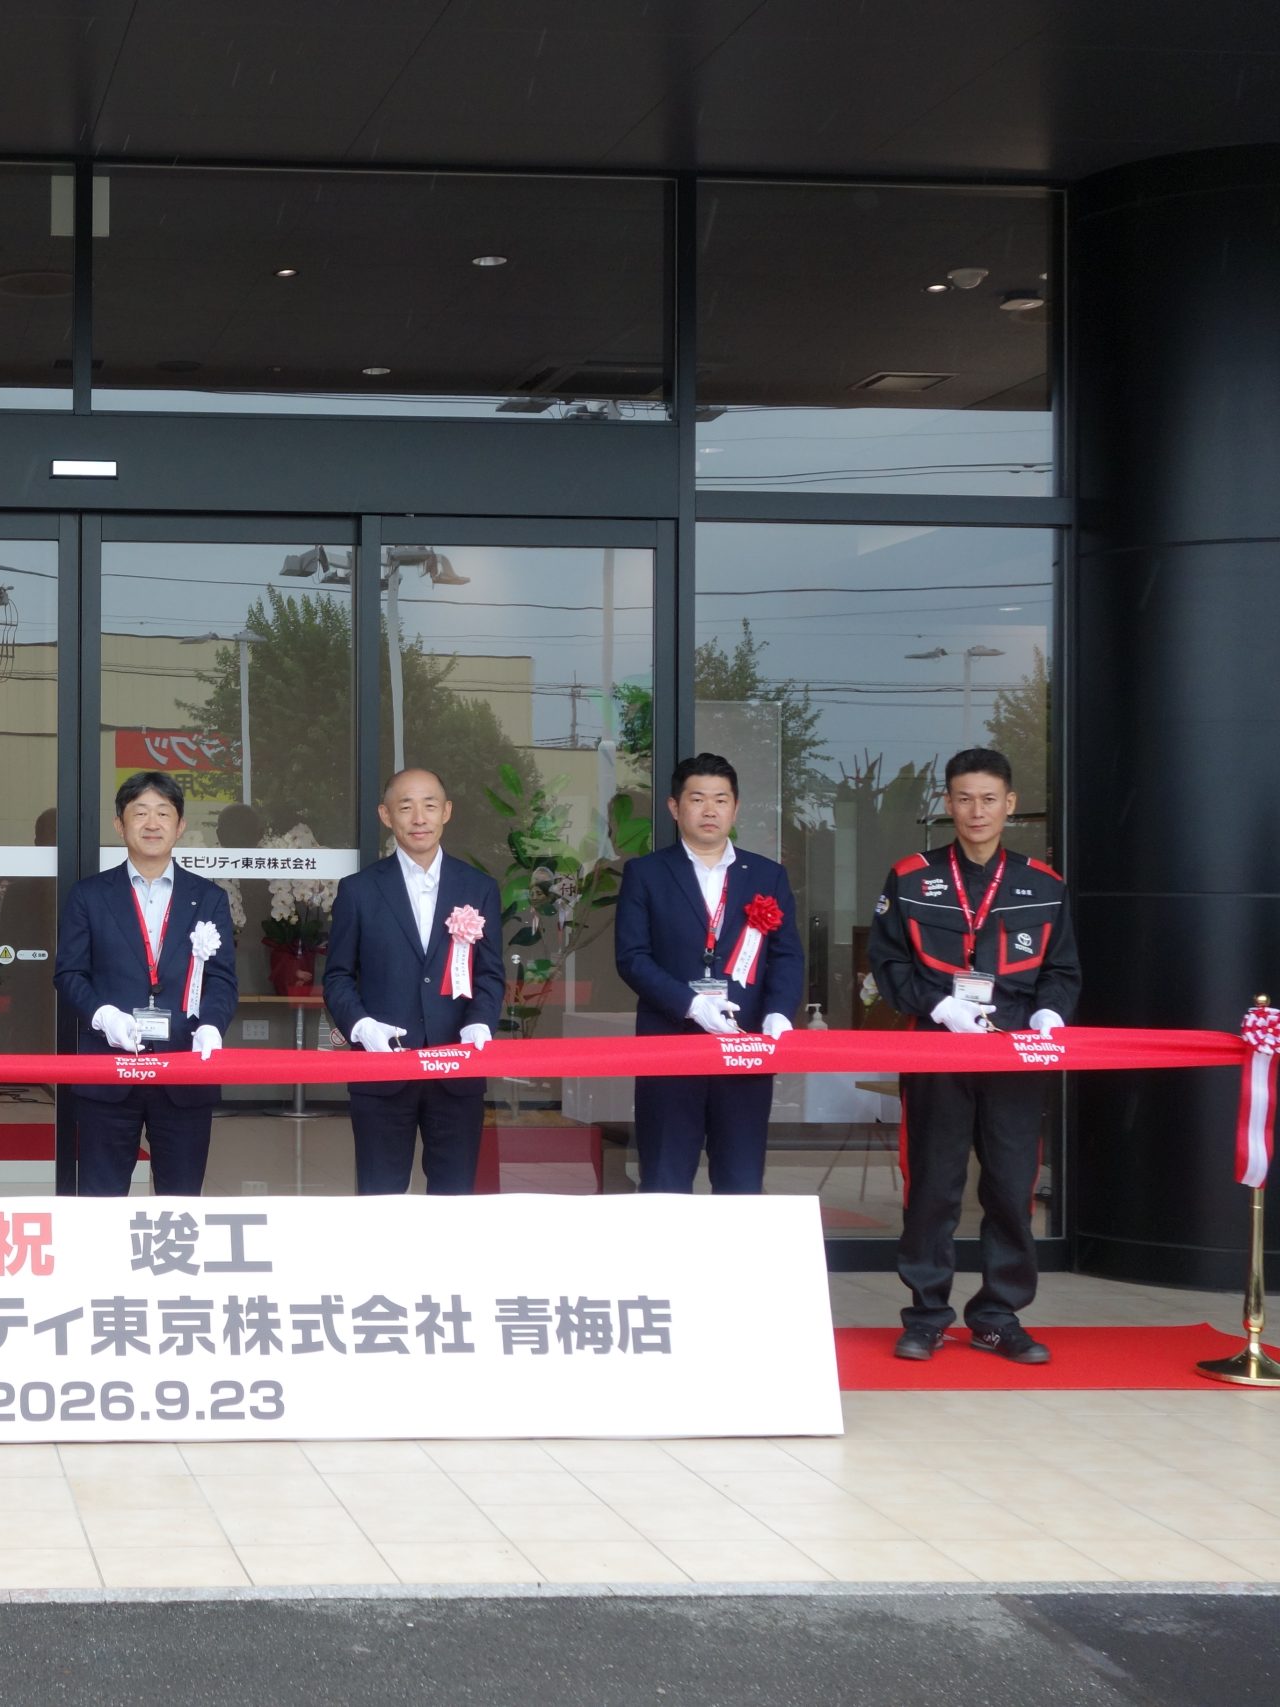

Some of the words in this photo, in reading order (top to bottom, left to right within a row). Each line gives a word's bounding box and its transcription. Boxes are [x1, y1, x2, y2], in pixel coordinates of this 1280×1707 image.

[181, 856, 317, 870] モビリティ東京株式会社
[721, 1043, 776, 1055] Mobility
[1013, 1042, 1066, 1053] Mobility
[723, 1056, 763, 1068] Tokyo
[1019, 1052, 1059, 1065] Tokyo
[420, 1060, 460, 1073] Tokyo
[117, 1068, 156, 1080] Tokyo
[129, 1211, 273, 1276] 竣工
[494, 1295, 673, 1356] 青梅店
